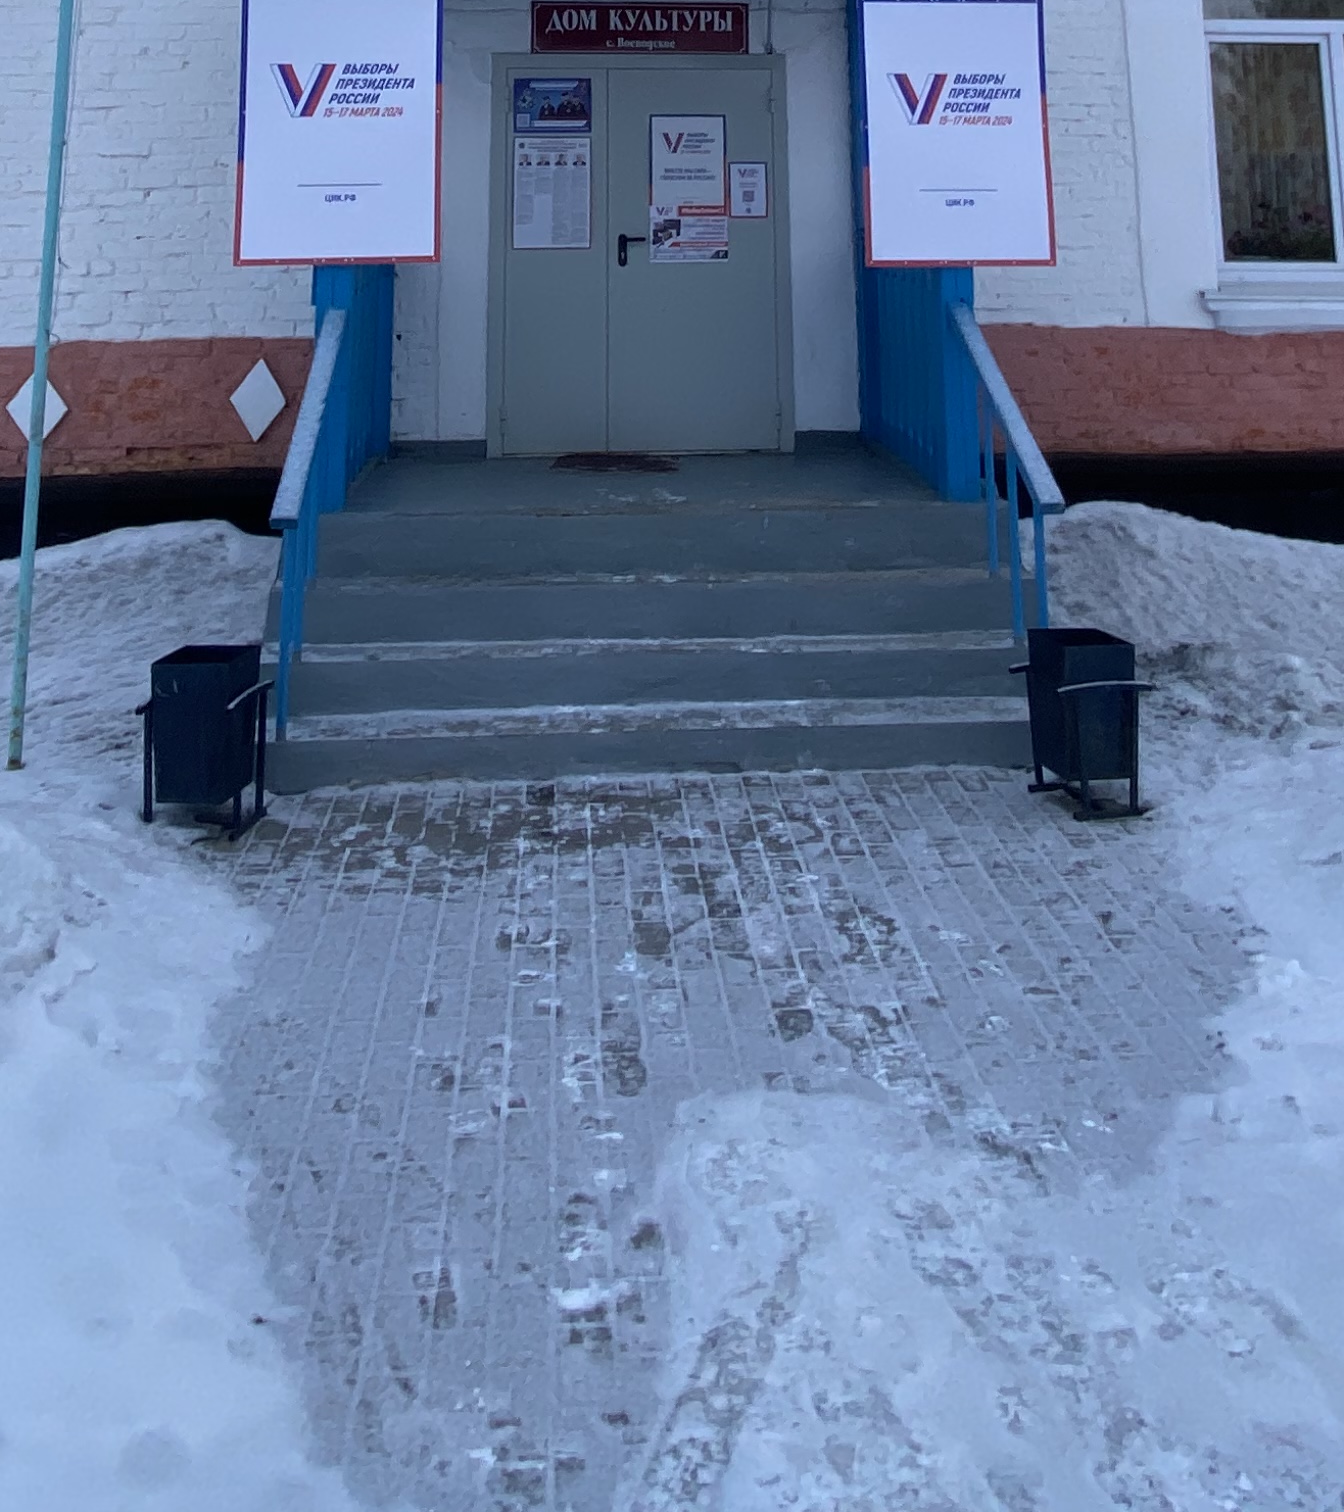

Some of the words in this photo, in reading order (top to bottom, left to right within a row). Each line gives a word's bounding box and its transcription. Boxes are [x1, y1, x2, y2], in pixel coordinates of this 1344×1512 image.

[544, 8, 598, 35] ДОМ
[609, 8, 734, 33] КУЛЬТУРЫ
[341, 63, 400, 75] ВЫБОРЫ
[335, 78, 415, 91] ПРЕЗИДЕНТА
[953, 73, 1007, 85] ВЫБОРЫ
[328, 92, 381, 105] РОССИИ
[948, 88, 1021, 100] ПРЕЗИДЕНТА
[349, 107, 381, 118] МАРТА
[381, 106, 404, 118] 2024
[942, 102, 991, 114] РОССИИ
[962, 116, 991, 126] МАРТА
[992, 116, 1013, 127] 2024
